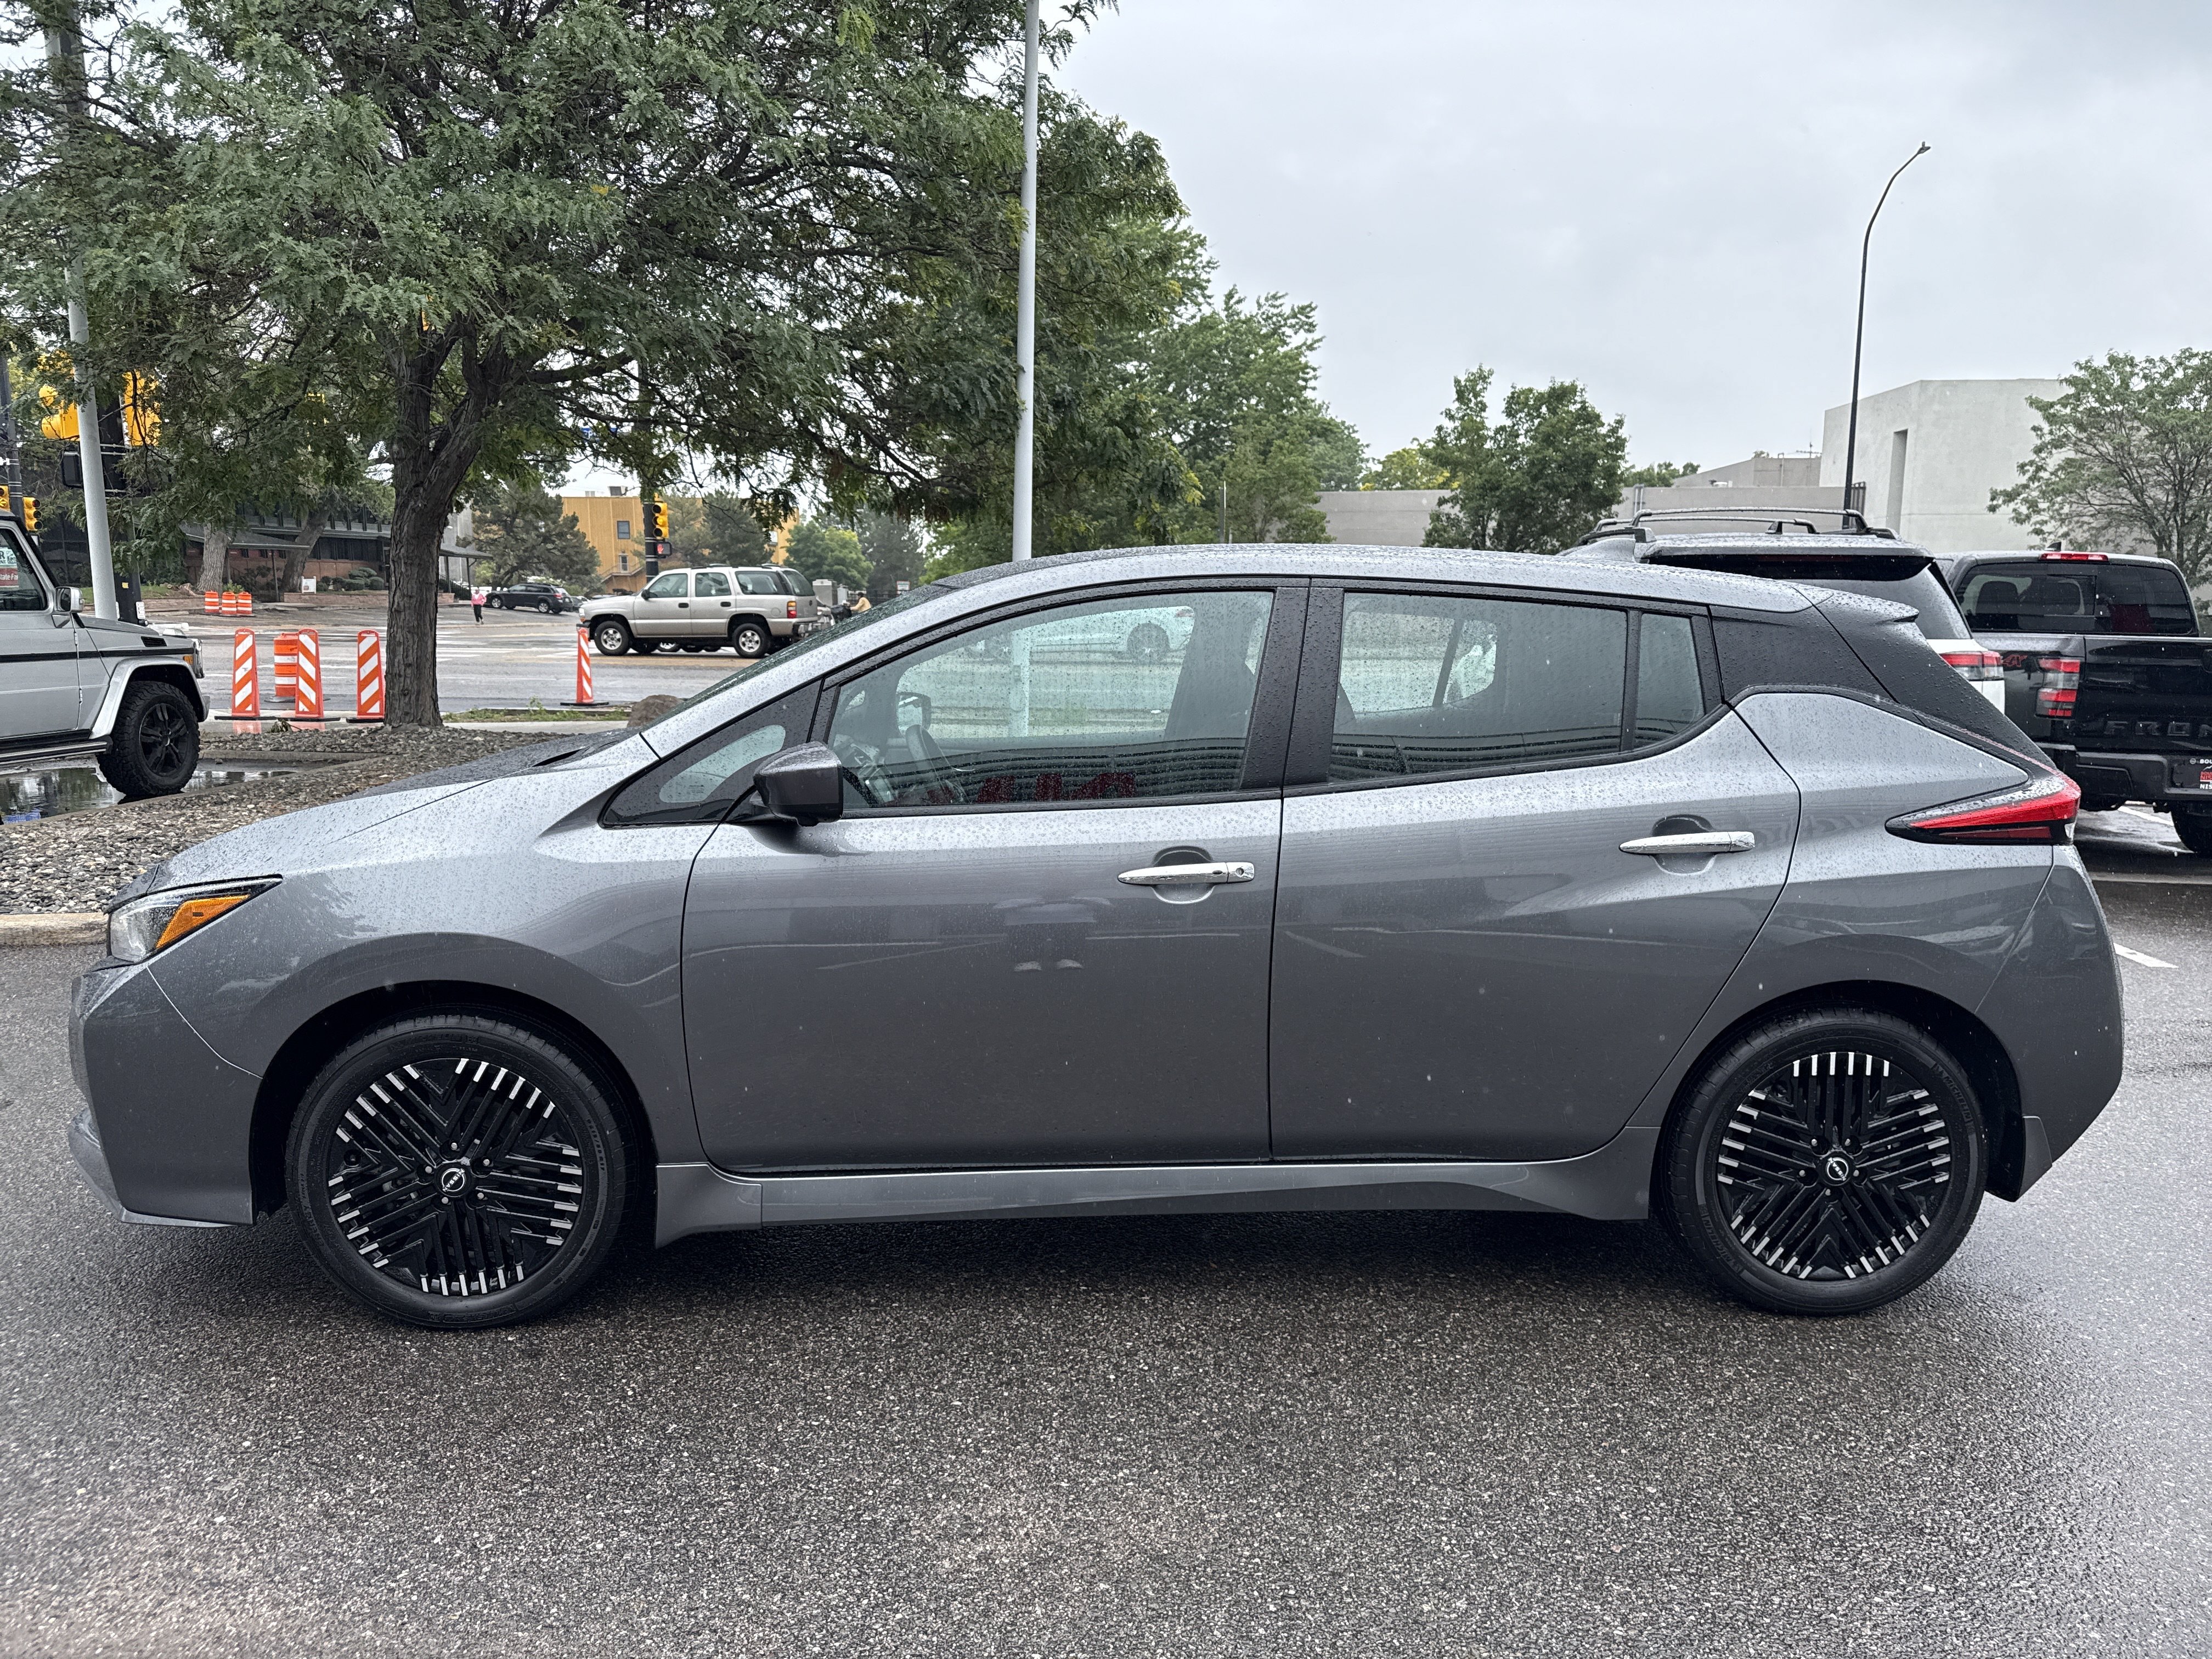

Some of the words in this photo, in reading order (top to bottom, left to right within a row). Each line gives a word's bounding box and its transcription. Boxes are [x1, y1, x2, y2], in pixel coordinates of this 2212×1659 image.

[1942, 1074, 1973, 1121] MICHELIN
[442, 1168, 465, 1192] NISSAN
[1827, 1157, 1847, 1181] NISSAN
[1702, 1218, 1734, 1263] MICHELIN
